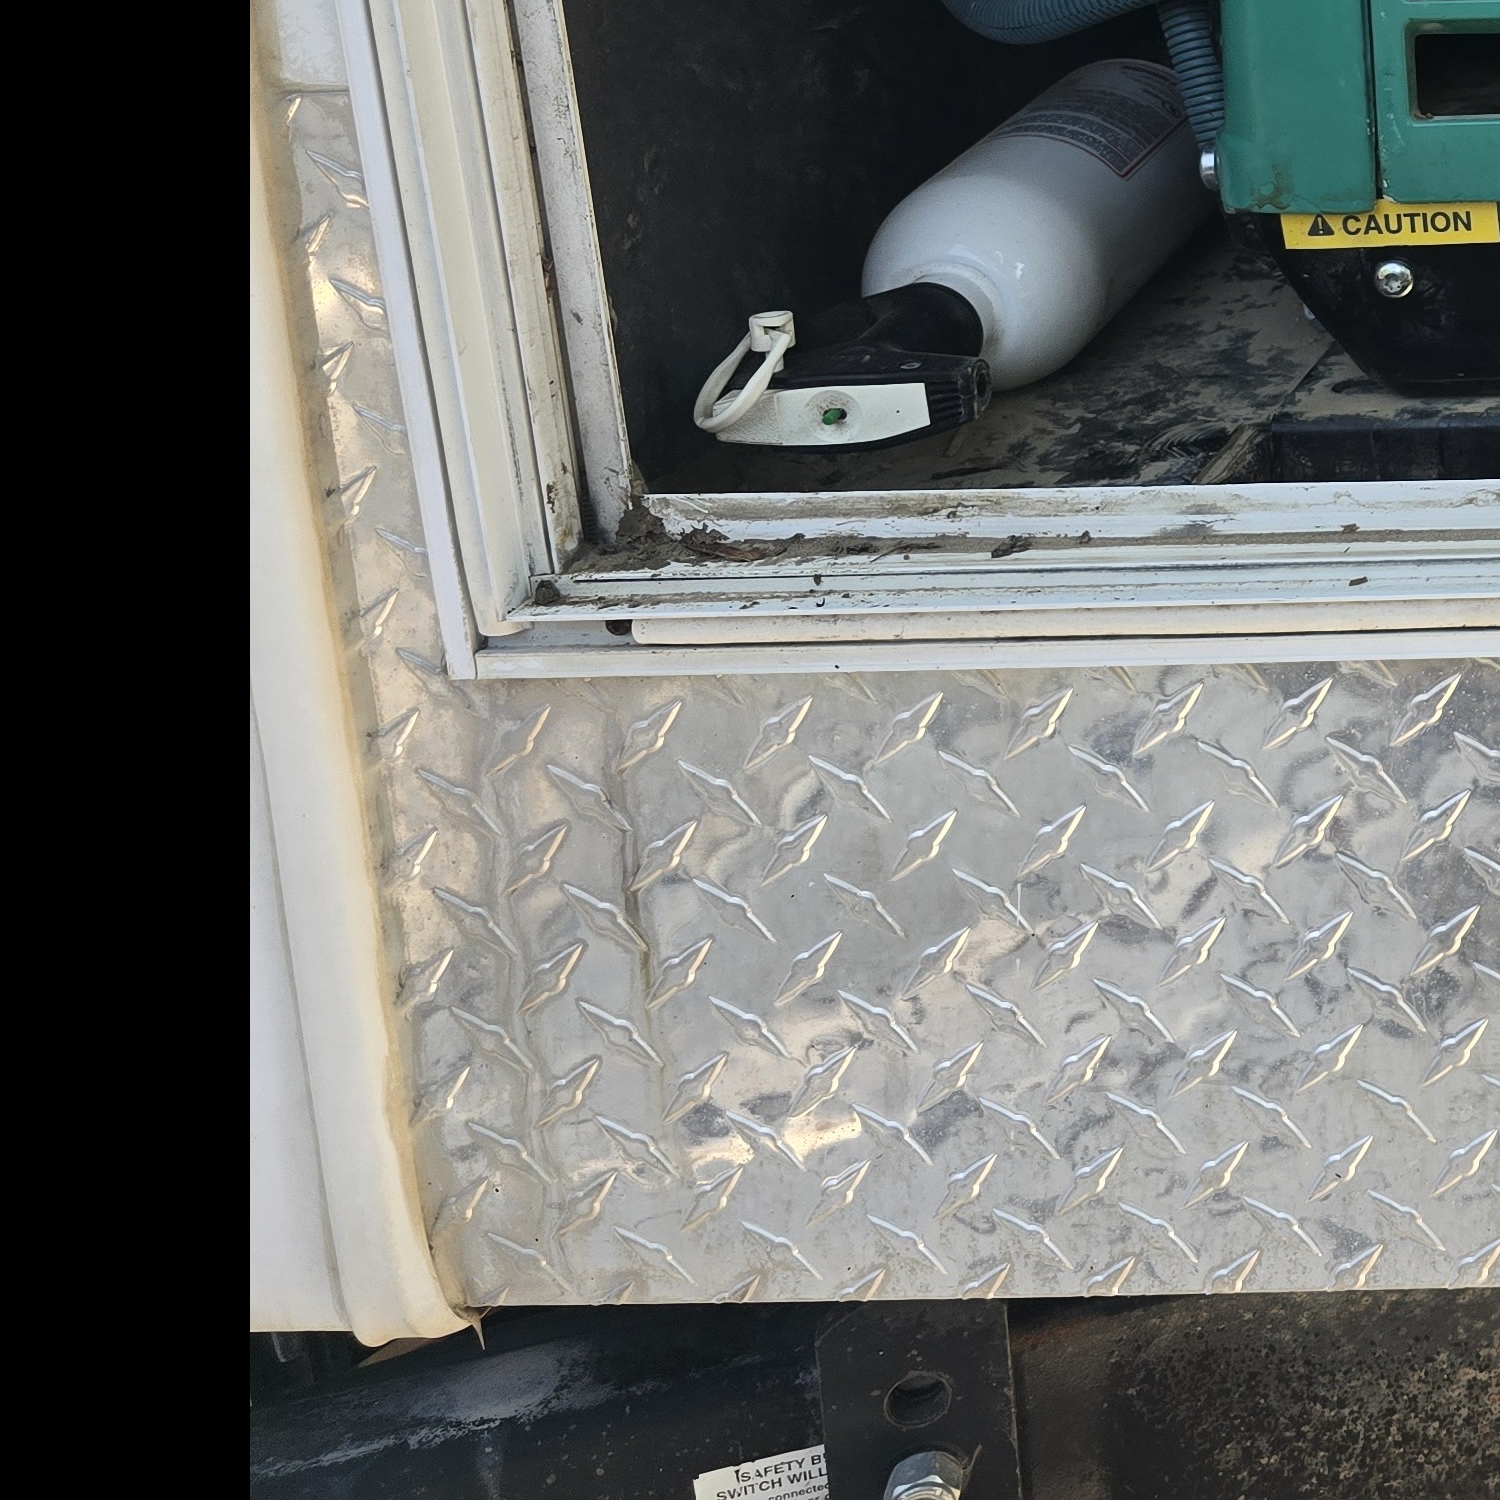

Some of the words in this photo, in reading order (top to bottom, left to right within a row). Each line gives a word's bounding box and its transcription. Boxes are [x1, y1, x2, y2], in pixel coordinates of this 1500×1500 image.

[1341, 210, 1472, 237] CAUTION
[715, 1476, 784, 1500] SWITCH
[786, 1466, 829, 1485] WILL
[740, 1457, 807, 1483] SAFETY
